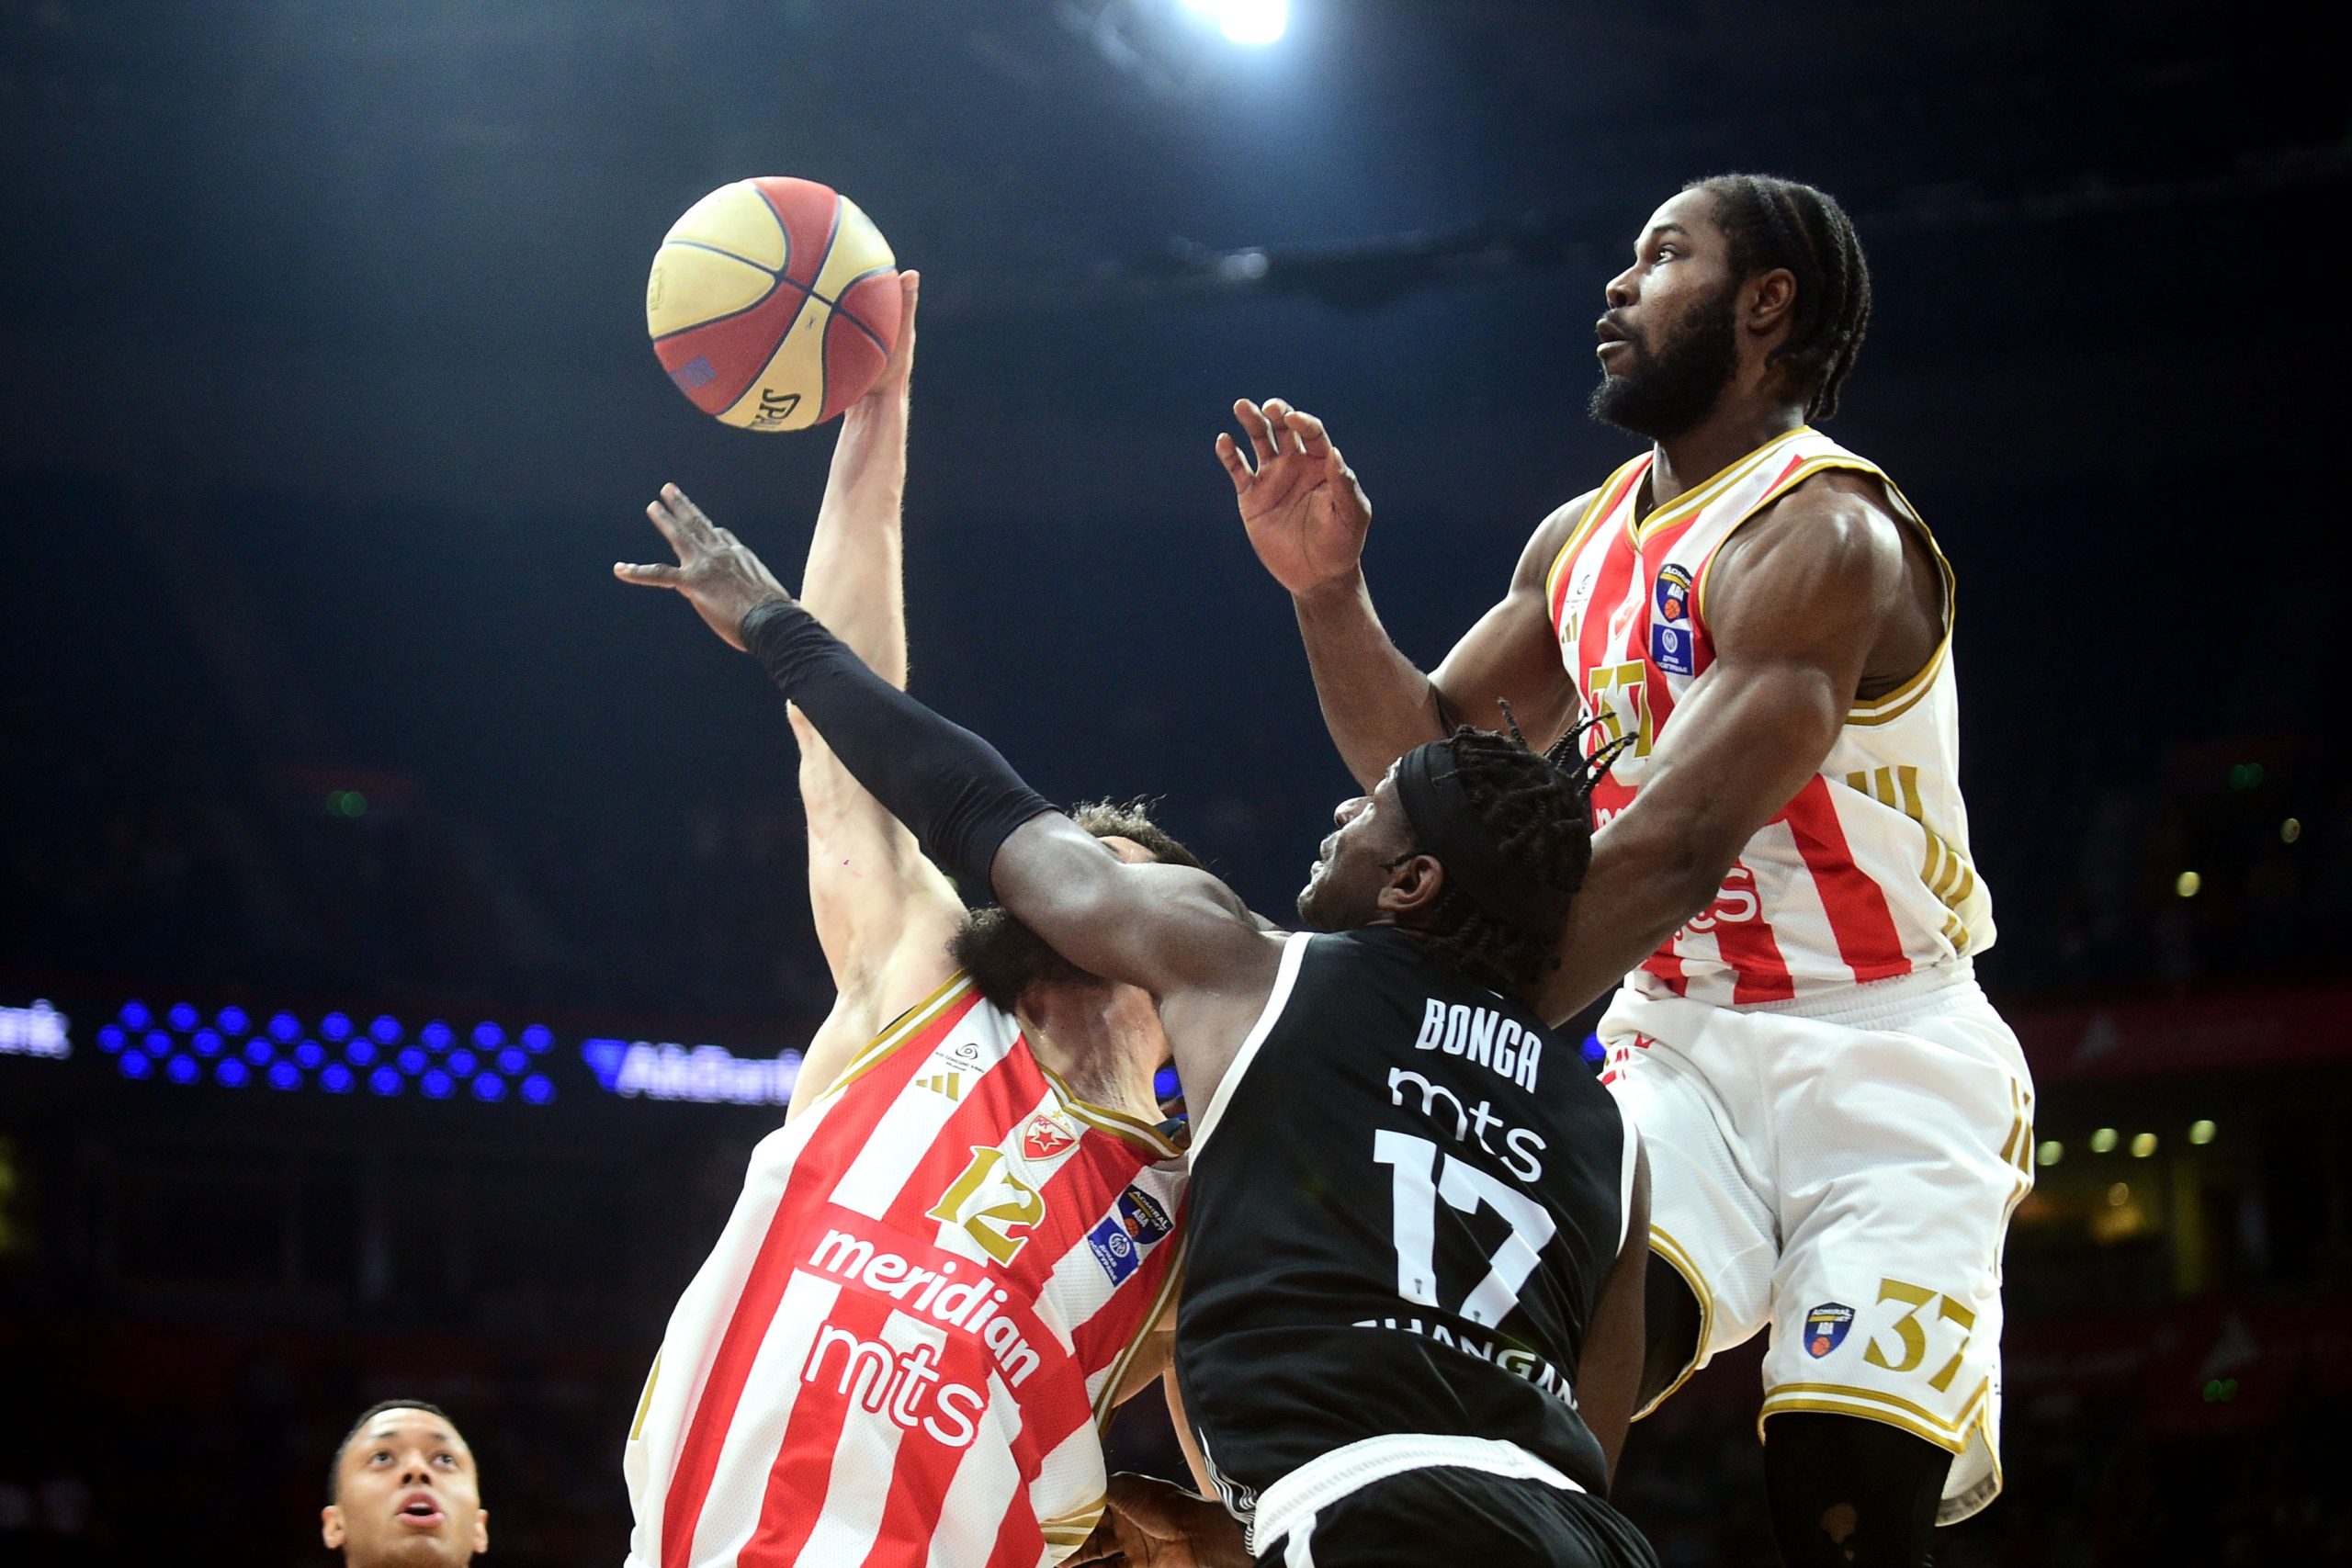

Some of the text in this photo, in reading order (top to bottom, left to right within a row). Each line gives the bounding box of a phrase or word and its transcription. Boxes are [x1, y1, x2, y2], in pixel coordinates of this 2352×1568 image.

[1414, 998, 1543, 1094] BONGA
[1387, 1066, 1547, 1183] mts
[926, 1145, 1046, 1268] 12
[1131, 1190, 1170, 1229] ADMIRAL
[1132, 1209, 1150, 1228] ABA
[1373, 1128, 1558, 1329] 17
[808, 1228, 1041, 1388] meridian
[1863, 1278, 1975, 1393] 37
[804, 1325, 988, 1448] mts
